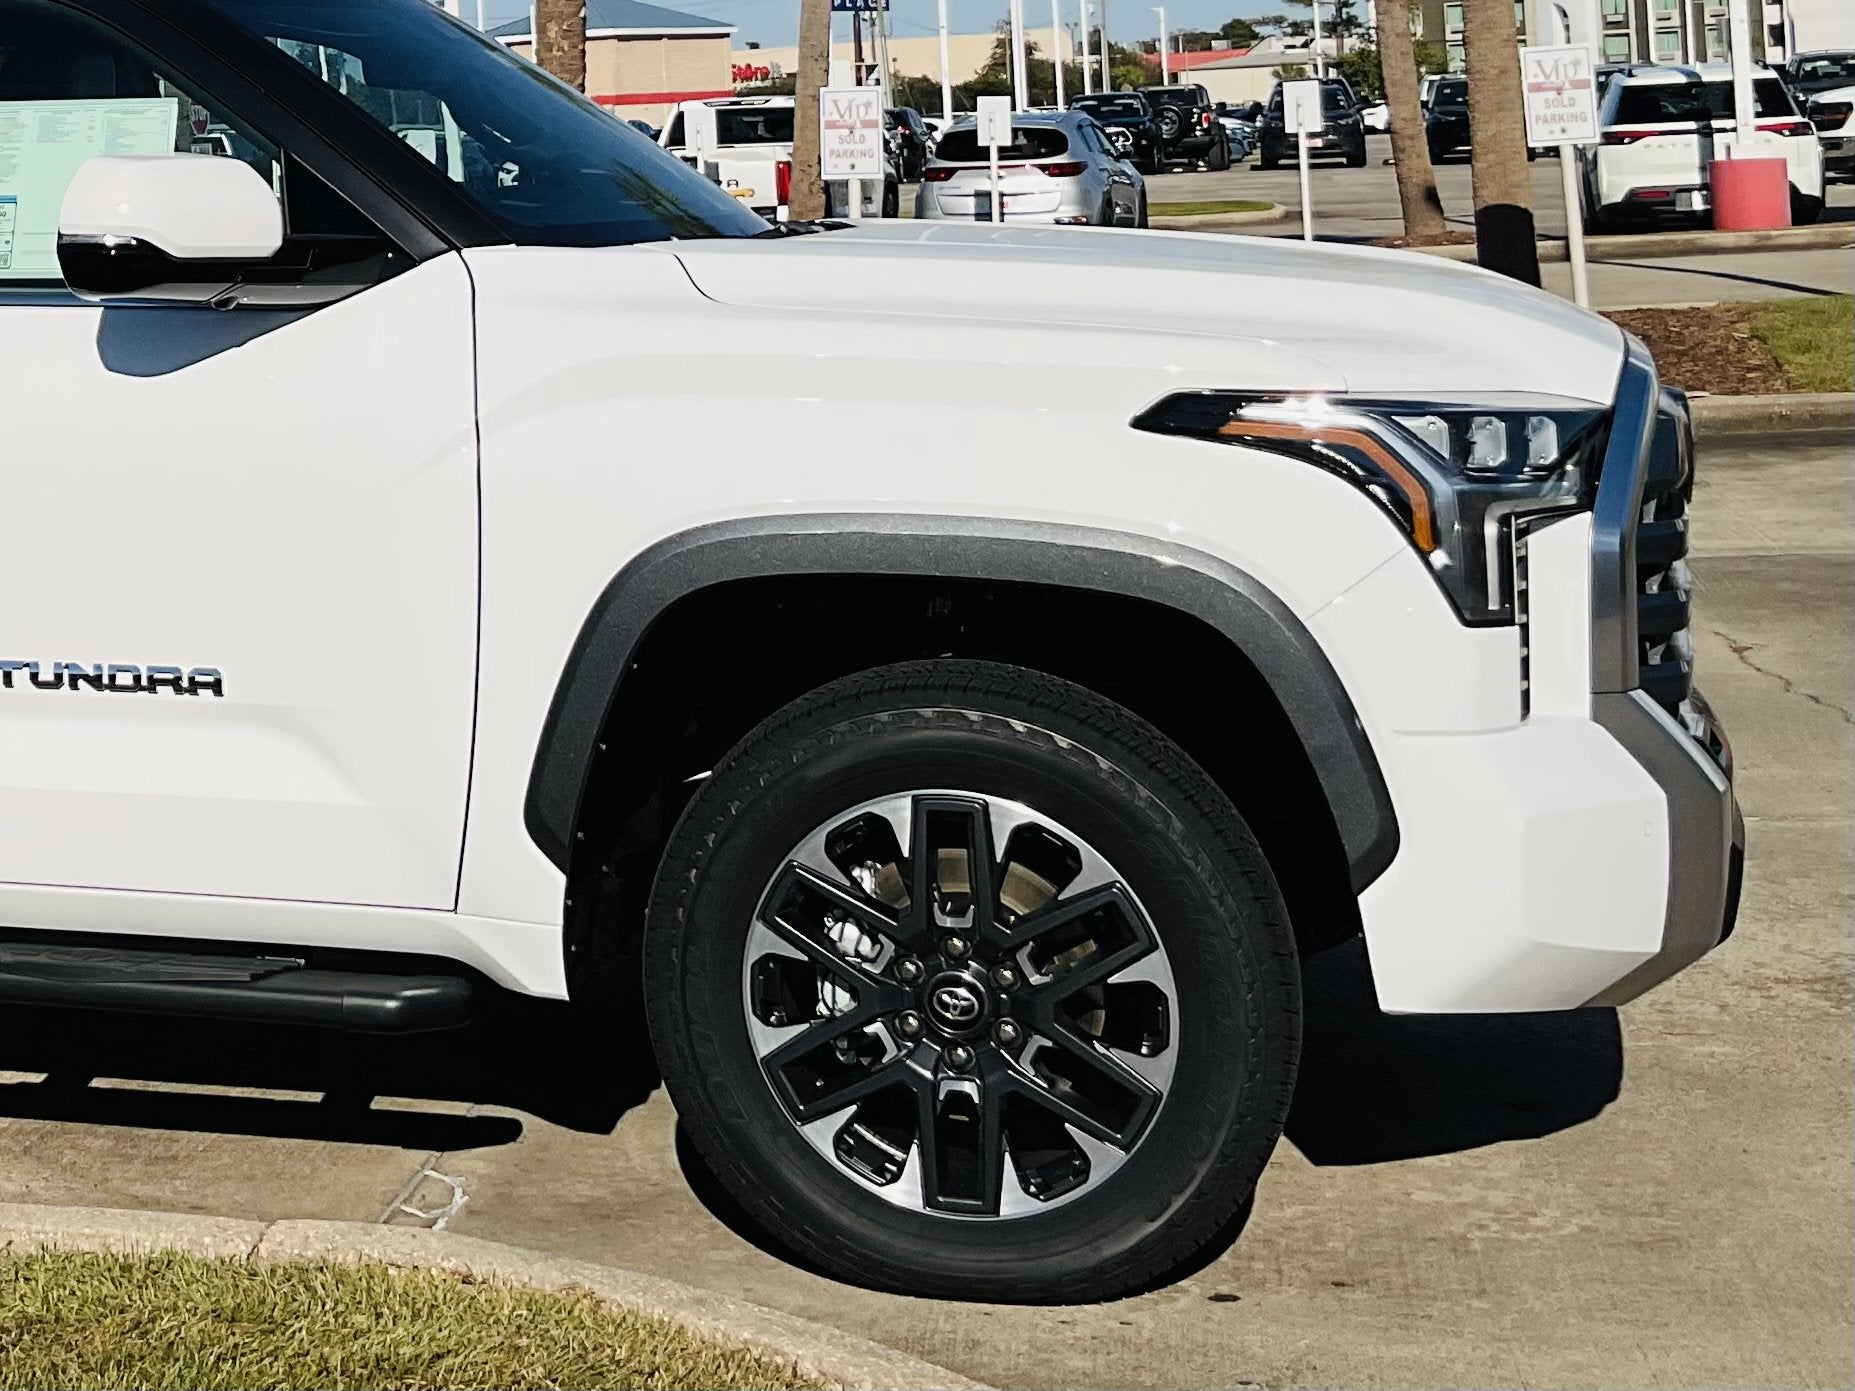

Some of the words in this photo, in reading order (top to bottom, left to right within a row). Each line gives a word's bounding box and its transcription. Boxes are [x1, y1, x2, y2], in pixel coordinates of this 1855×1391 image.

[1544, 96, 1576, 109] SOLD
[1535, 111, 1588, 125] PARKING
[838, 134, 866, 145] SOLD
[829, 148, 875, 159] PARKING
